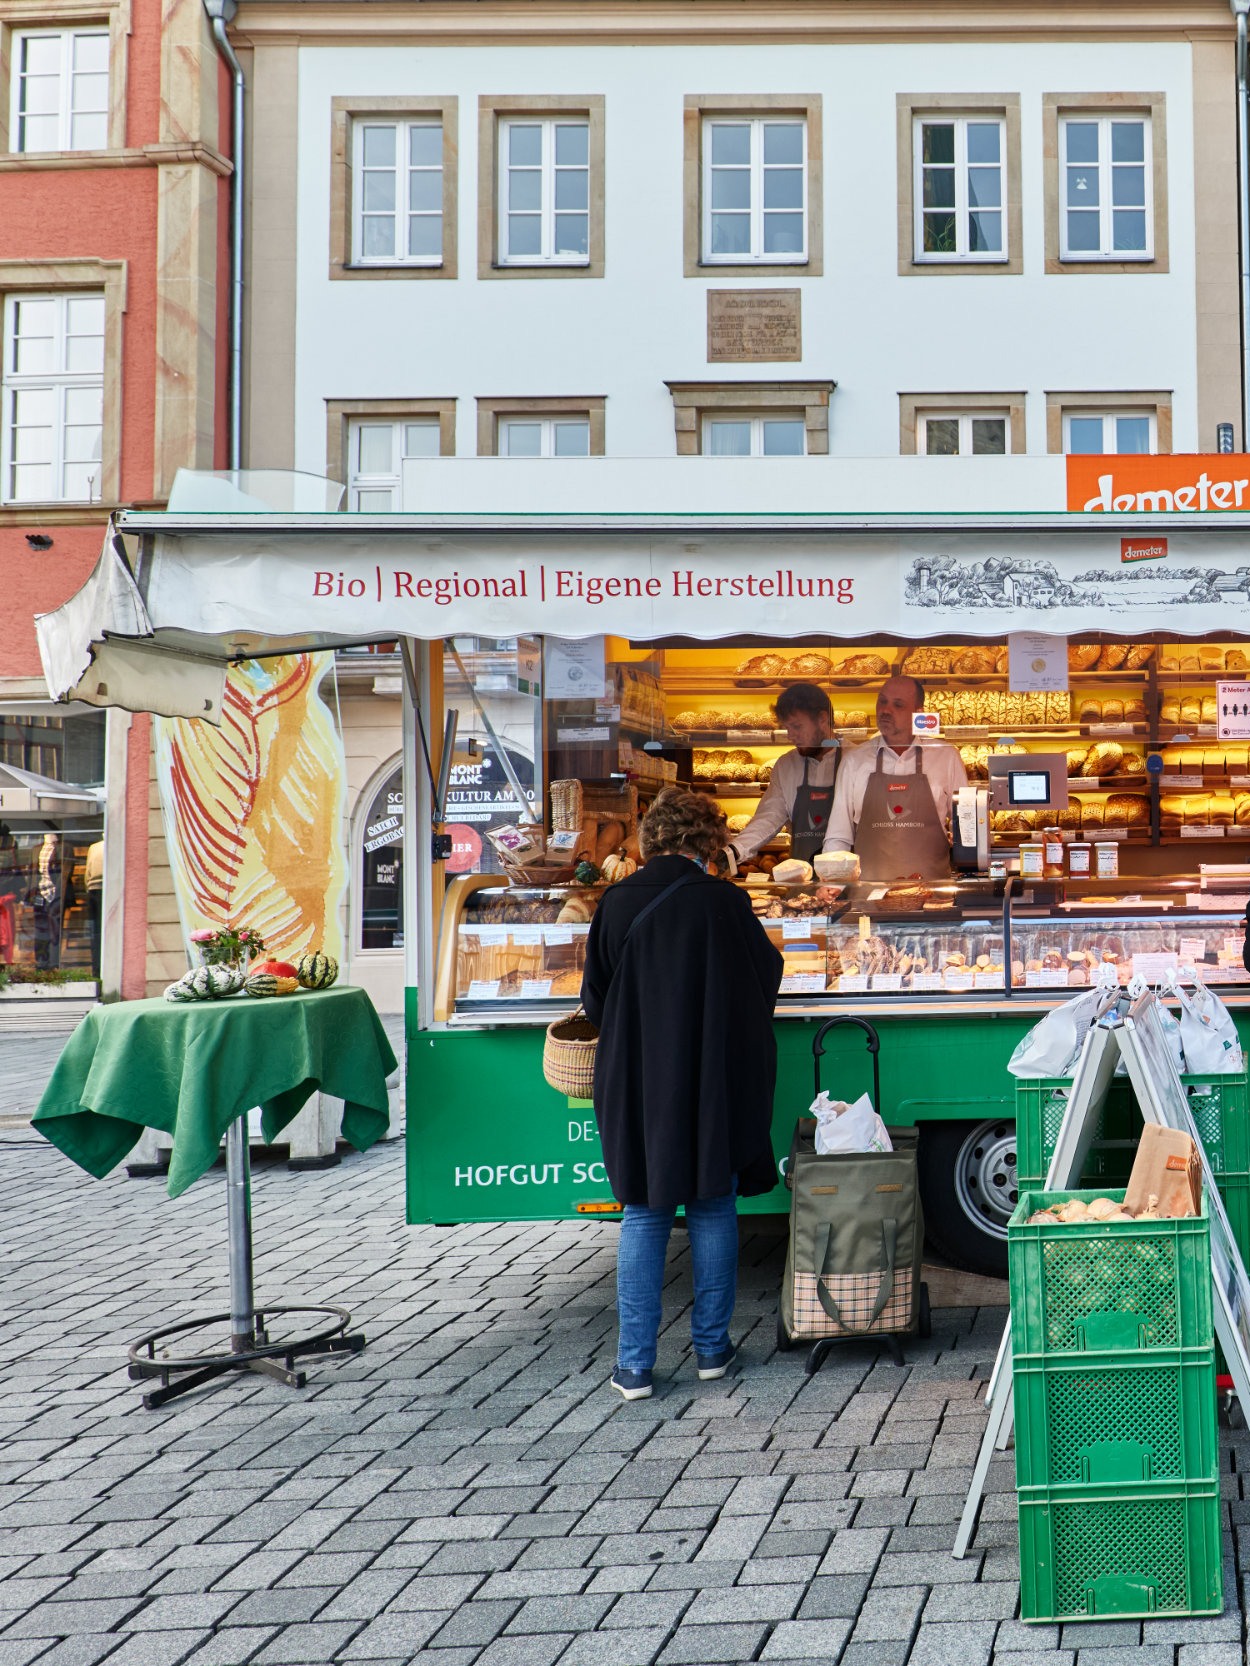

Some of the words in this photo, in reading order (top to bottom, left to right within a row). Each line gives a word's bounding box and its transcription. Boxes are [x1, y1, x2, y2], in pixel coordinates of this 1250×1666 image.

[1084, 473, 1249, 512] demeter
[1124, 546, 1162, 559] demeter
[312, 571, 366, 597] Bio
[393, 570, 528, 605] Regional
[555, 571, 662, 605] Eigene
[672, 570, 854, 605] Herstellung
[494, 790, 513, 801] AM
[368, 817, 398, 834] SATCH
[366, 828, 403, 851] ERGOBAC
[453, 843, 472, 853] IER
[377, 864, 394, 873] MONT
[377, 874, 395, 883] BLANC
[455, 1163, 564, 1187] HOFGUT
[573, 1162, 608, 1184] SC
